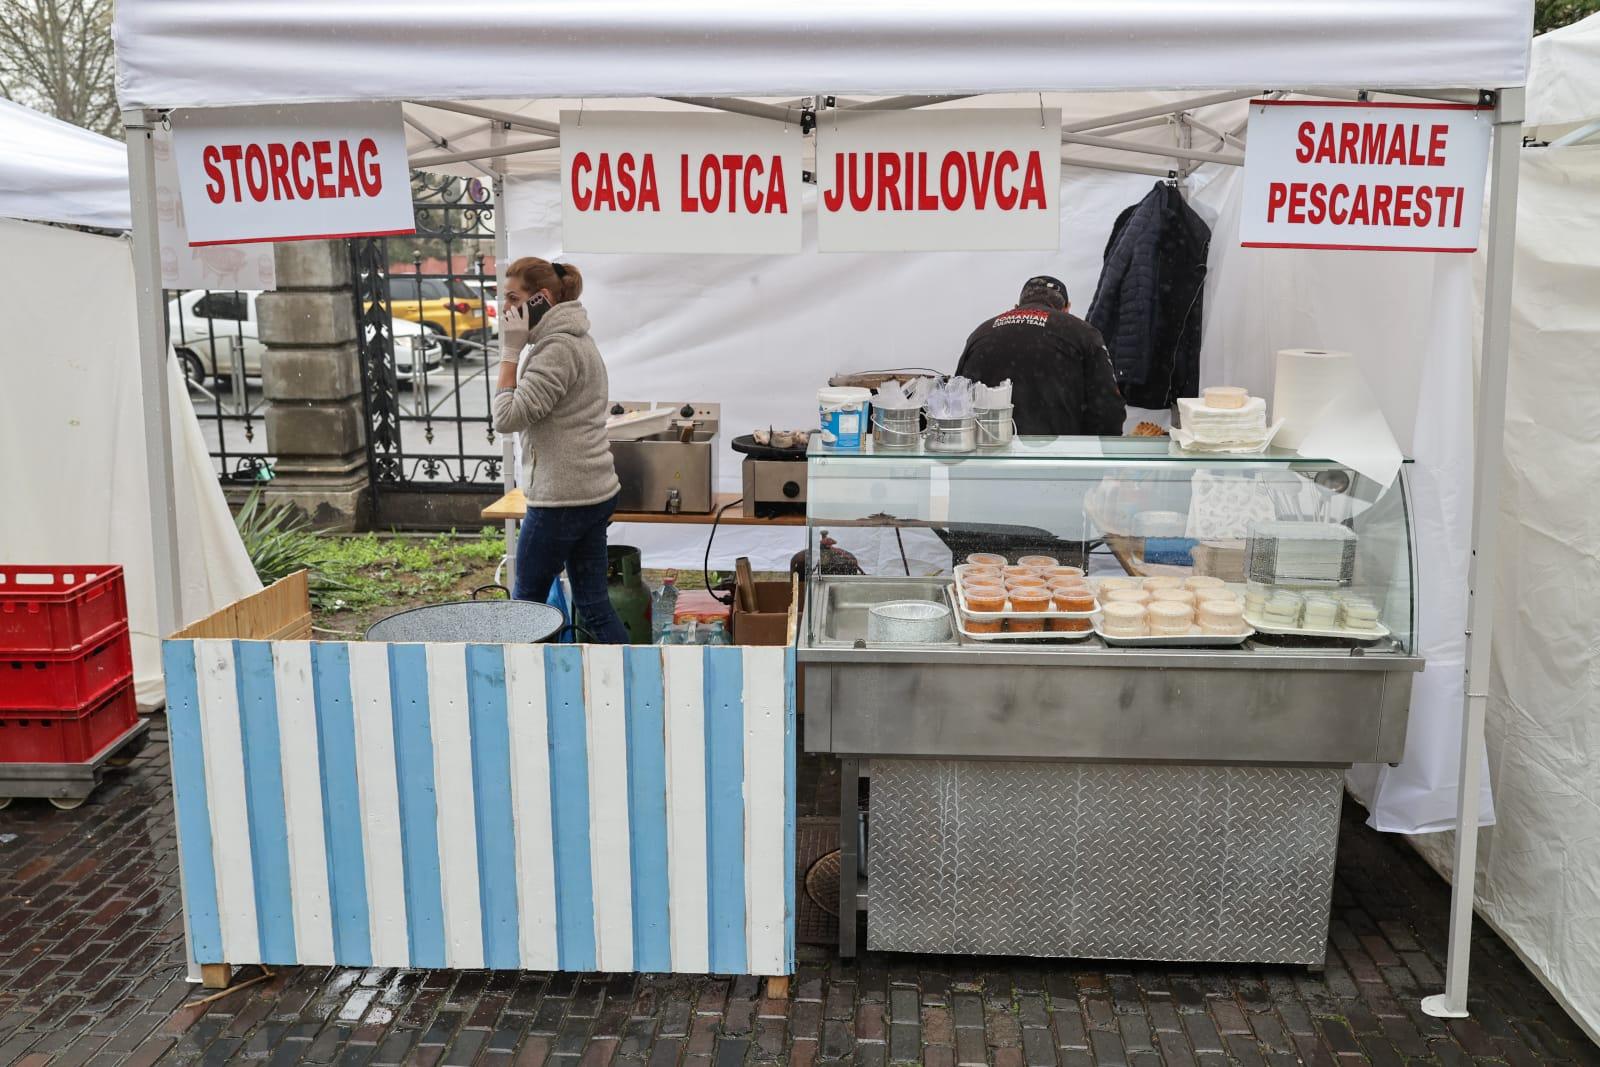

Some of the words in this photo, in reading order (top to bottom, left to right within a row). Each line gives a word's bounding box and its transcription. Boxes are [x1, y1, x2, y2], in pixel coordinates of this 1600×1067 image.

[203, 138, 382, 204] STORCEAG
[1295, 121, 1449, 166] SARMALE
[571, 151, 660, 212] CASA
[681, 153, 788, 214] LOTCA
[823, 150, 1047, 212] JURILOVCA
[1267, 182, 1464, 228] PESCARESTI
